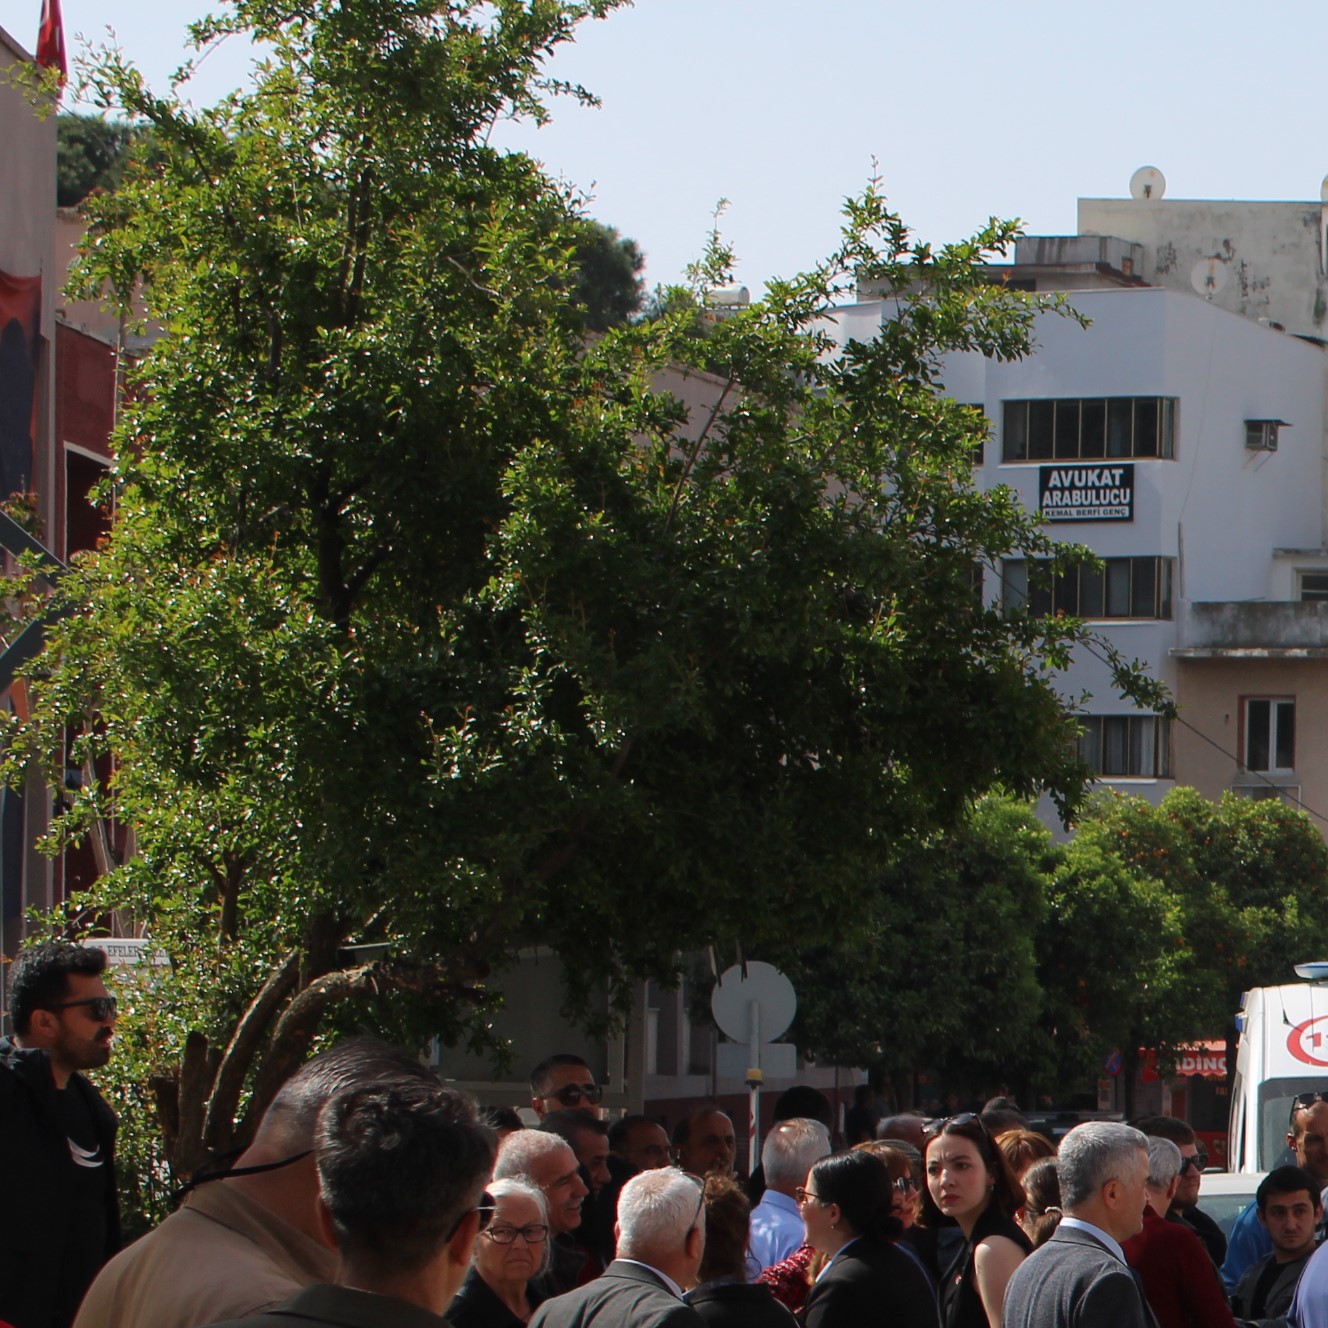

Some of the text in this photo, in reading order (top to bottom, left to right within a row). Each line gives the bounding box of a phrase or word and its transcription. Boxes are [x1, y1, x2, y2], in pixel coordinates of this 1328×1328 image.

[1048, 469, 1124, 488] AVUKAT
[1042, 488, 1130, 507] ARABULUCU
[1045, 508, 1073, 517] KEMAL
[1103, 507, 1126, 518] GENÇ
